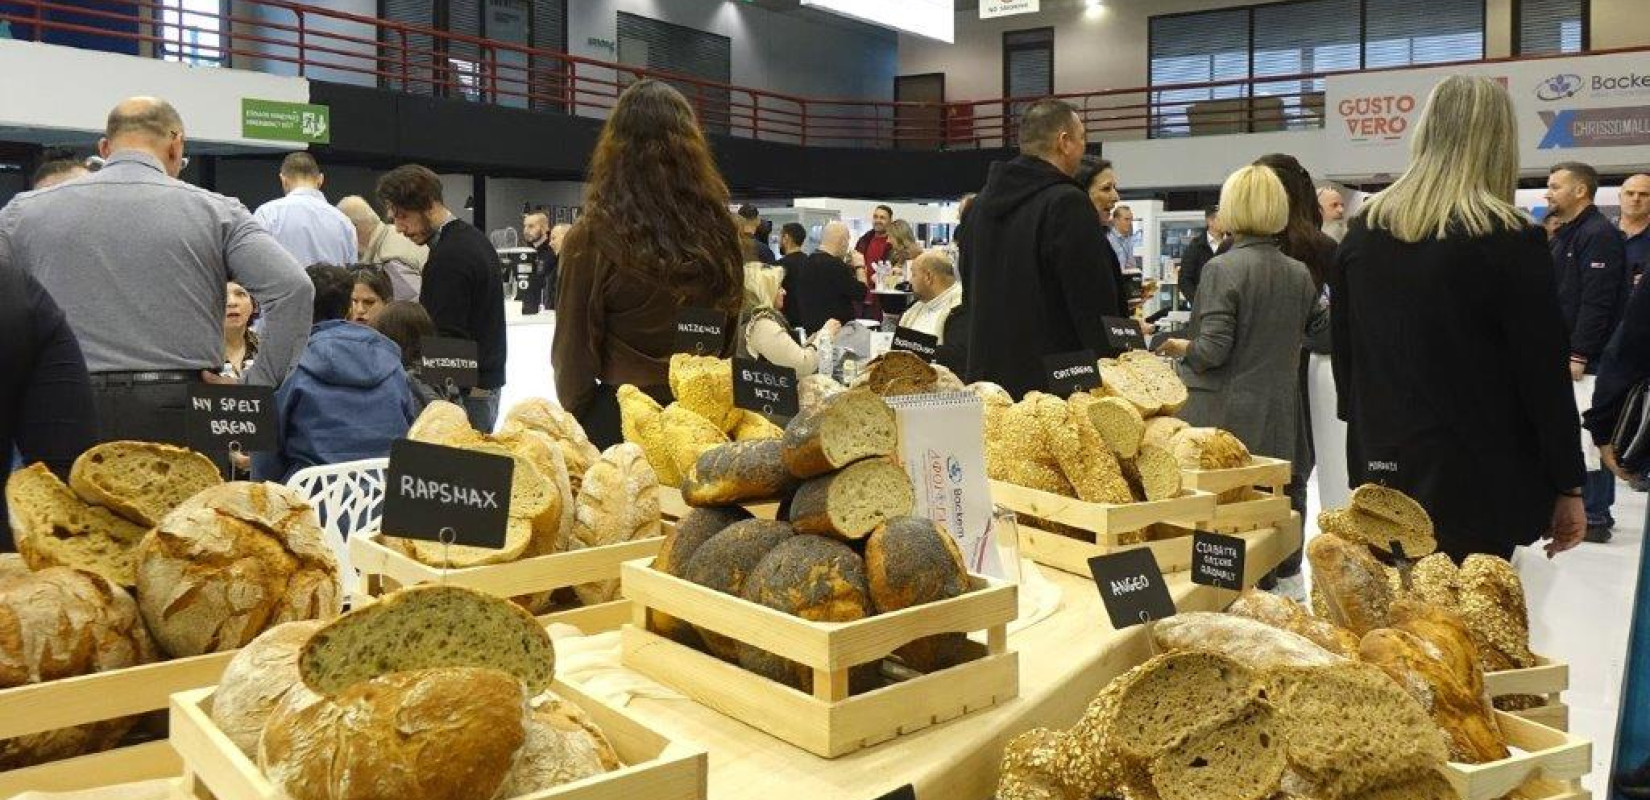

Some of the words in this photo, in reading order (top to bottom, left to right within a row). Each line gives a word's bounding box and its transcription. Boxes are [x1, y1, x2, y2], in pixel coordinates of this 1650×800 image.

[1591, 73, 1650, 90] Backe
[1344, 116, 1408, 136] VERO
[742, 369, 790, 388] BIBLE
[220, 397, 261, 413] SPELT
[210, 420, 257, 435] BREAD
[400, 475, 498, 508] RAPSMAX
